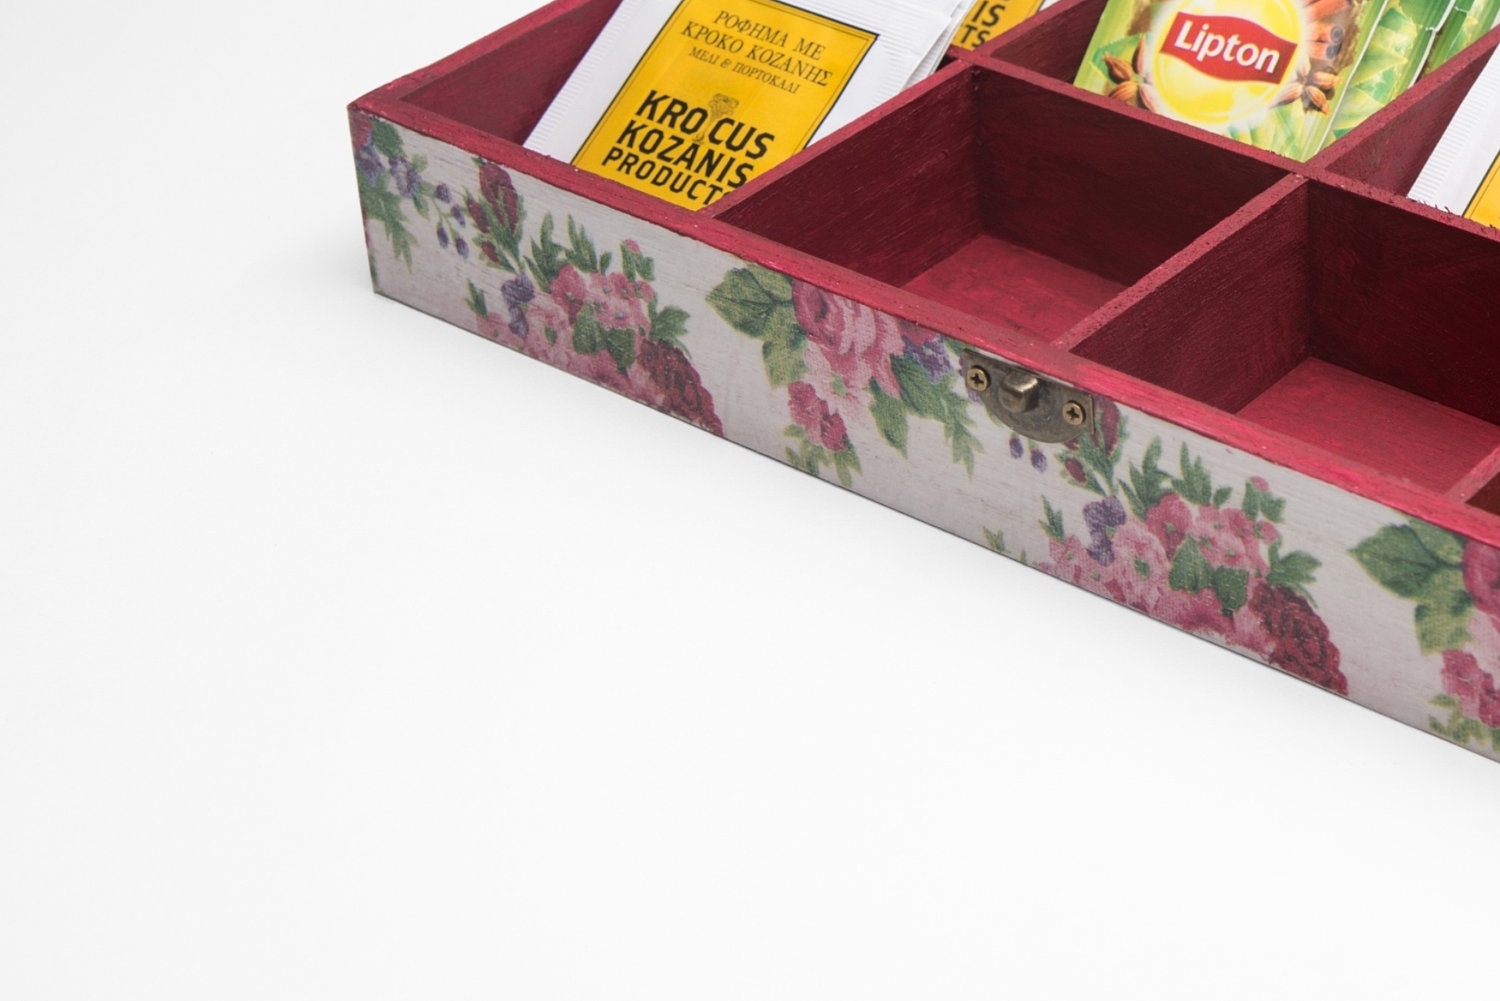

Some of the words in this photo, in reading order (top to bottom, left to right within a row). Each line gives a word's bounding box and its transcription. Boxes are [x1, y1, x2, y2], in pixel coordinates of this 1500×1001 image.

[681, 21, 744, 52] ΚΡΟΚΟ
[746, 47, 833, 86] ΚΟΖΑΝΗΣ
[714, 11, 788, 48] ΡΟΦΗΜΑ
[793, 38, 826, 60] ΜΕ
[1173, 20, 1281, 74] Lipton
[616, 120, 754, 188] KOZANIS
